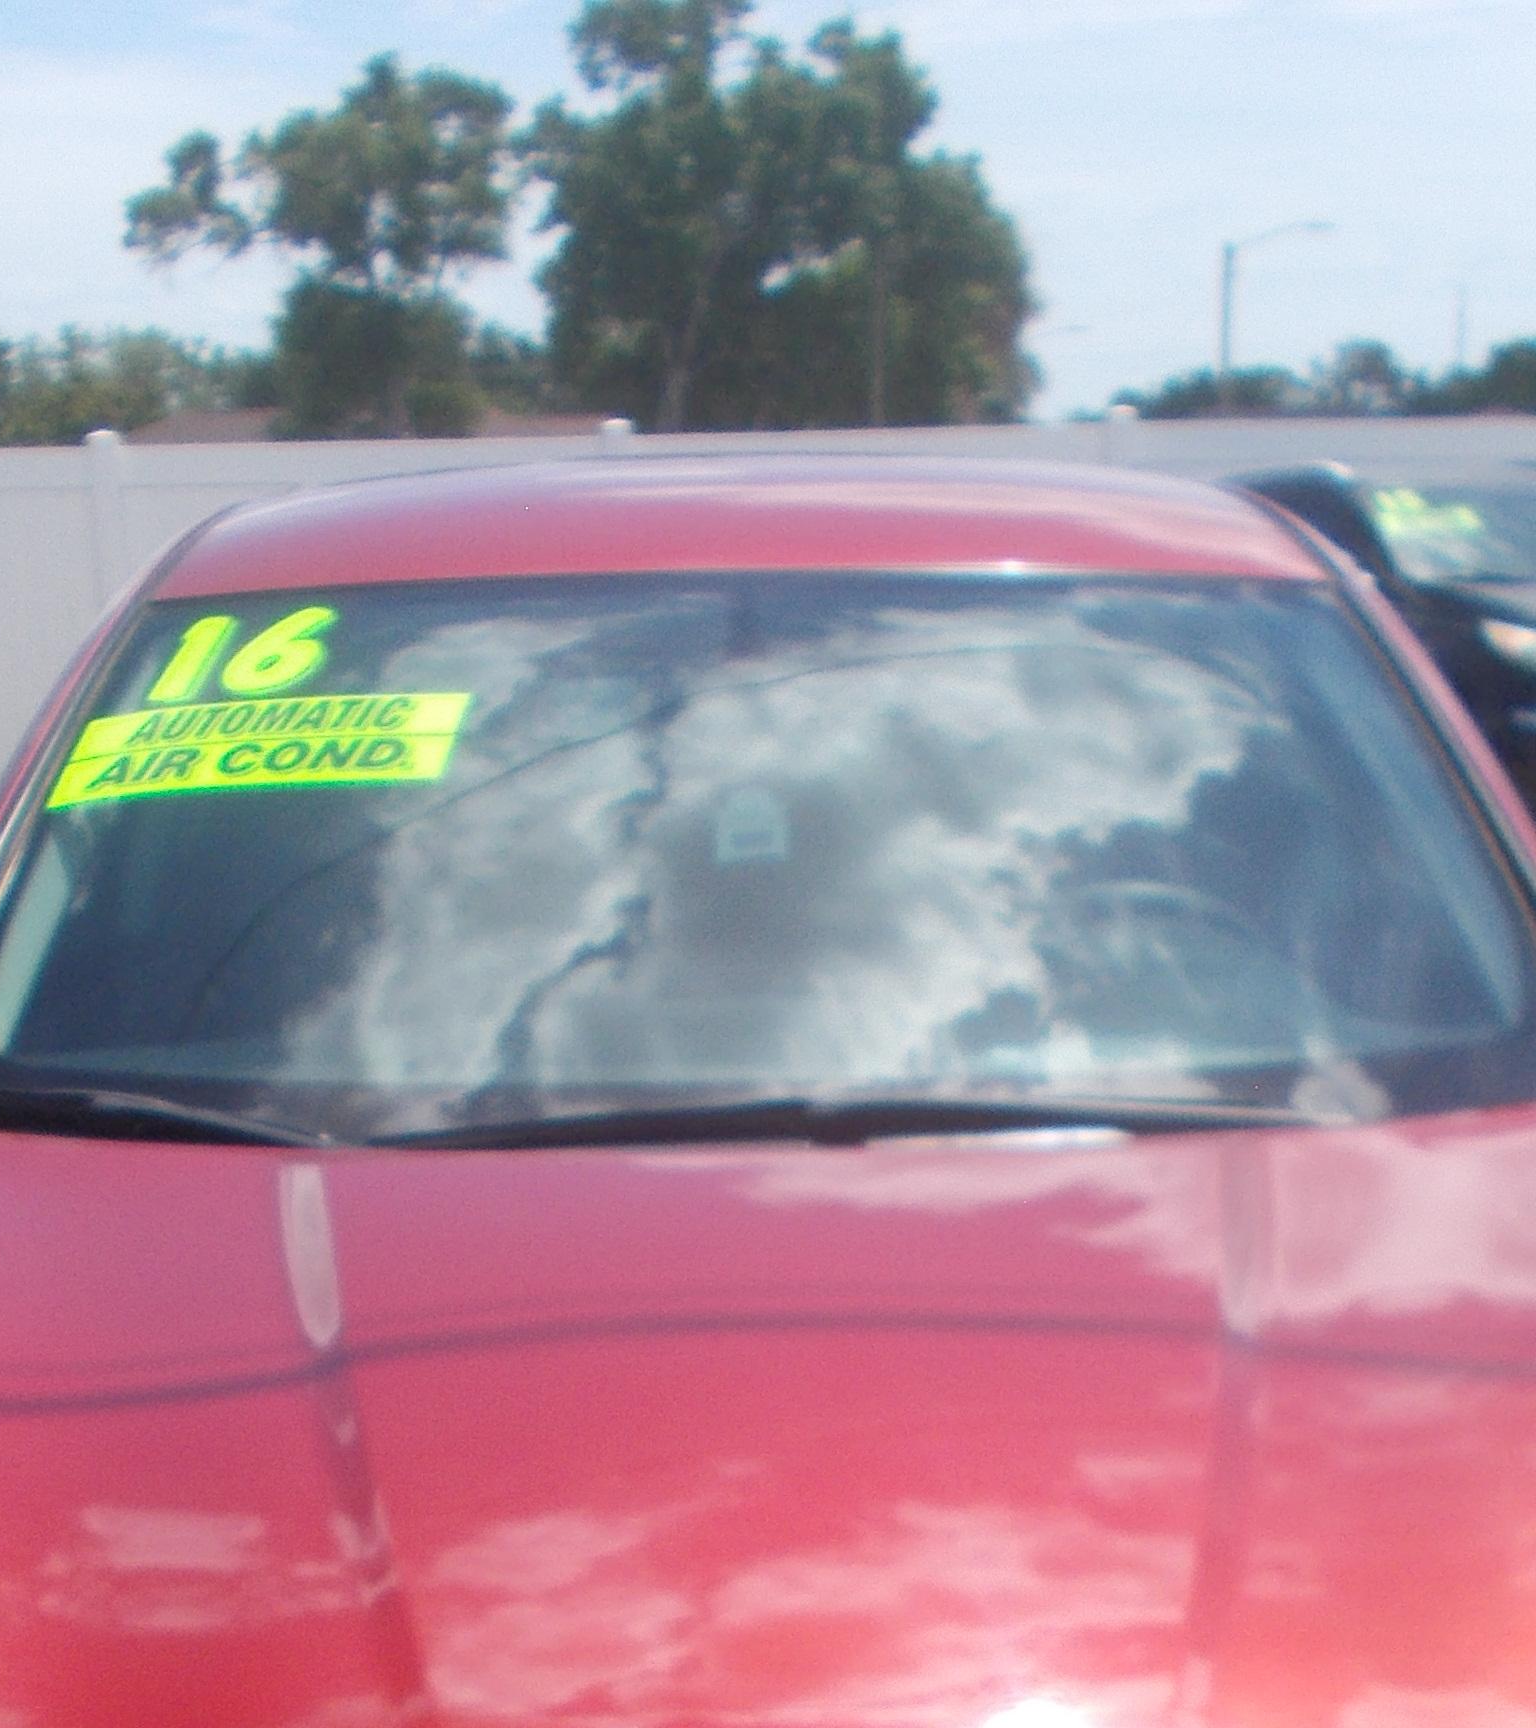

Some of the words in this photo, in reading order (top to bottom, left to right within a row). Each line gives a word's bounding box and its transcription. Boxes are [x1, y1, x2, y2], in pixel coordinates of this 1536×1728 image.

[146, 605, 340, 703] 16
[126, 697, 410, 746] AUTOMATIC
[85, 747, 201, 791] AIR
